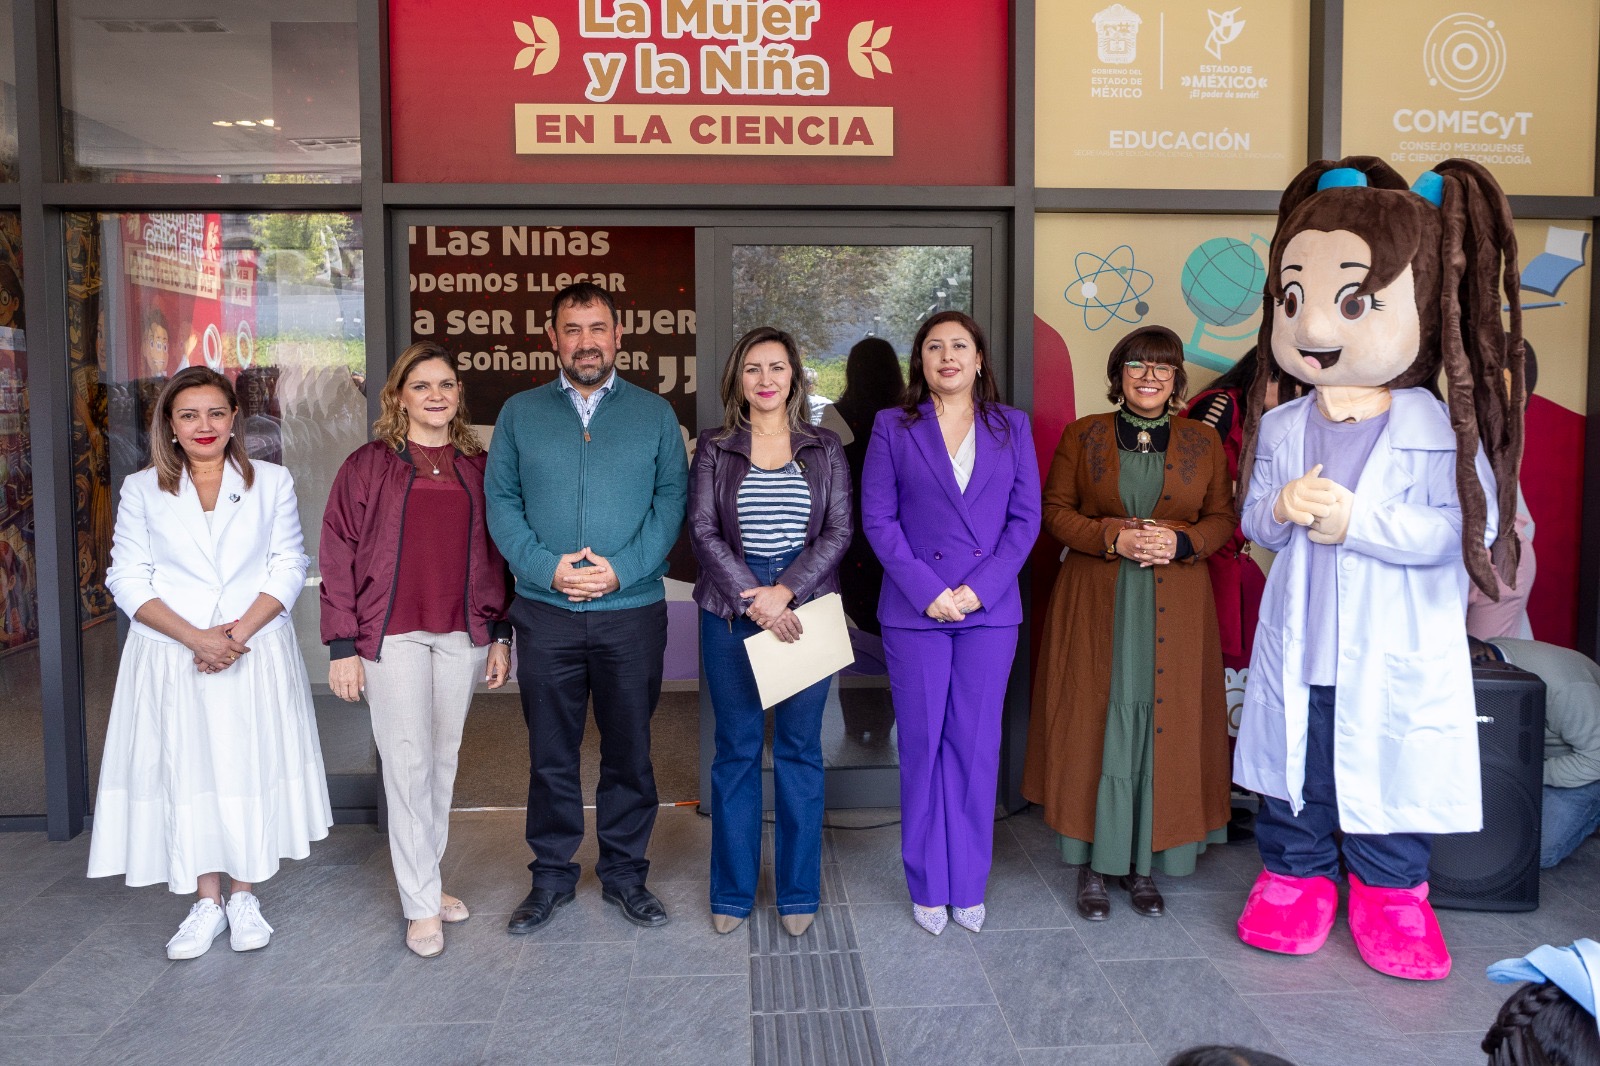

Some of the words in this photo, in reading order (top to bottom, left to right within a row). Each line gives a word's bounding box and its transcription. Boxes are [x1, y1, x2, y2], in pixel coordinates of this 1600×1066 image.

[581, 0, 649, 36] La
[664, 0, 818, 42] Mujer
[586, 55, 625, 100] y
[638, 46, 688, 91] la
[703, 45, 828, 94] Niña
[1200, 65, 1238, 73] ESTADO
[1240, 66, 1253, 74] DE
[1091, 77, 1128, 85] ESTADO
[1192, 75, 1258, 89] MÉXICO
[1091, 85, 1143, 98] MÉXICO
[1189, 90, 1200, 99] ¡El
[1201, 90, 1224, 99] poder
[1225, 90, 1234, 98] de
[1235, 90, 1259, 99] servir!
[1393, 108, 1533, 139] COMECyT
[536, 114, 595, 144] EN
[613, 114, 672, 144] LA
[689, 115, 875, 147] CIENCIA
[1109, 127, 1250, 150] EDUCACIÓN
[1400, 141, 1450, 151] CONSEJO
[1454, 142, 1524, 153] MEXIQUENSE
[1391, 152, 1405, 162] DE
[1408, 152, 1450, 163] CIENCIA
[1463, 154, 1532, 165] TECNOLOGÍA
